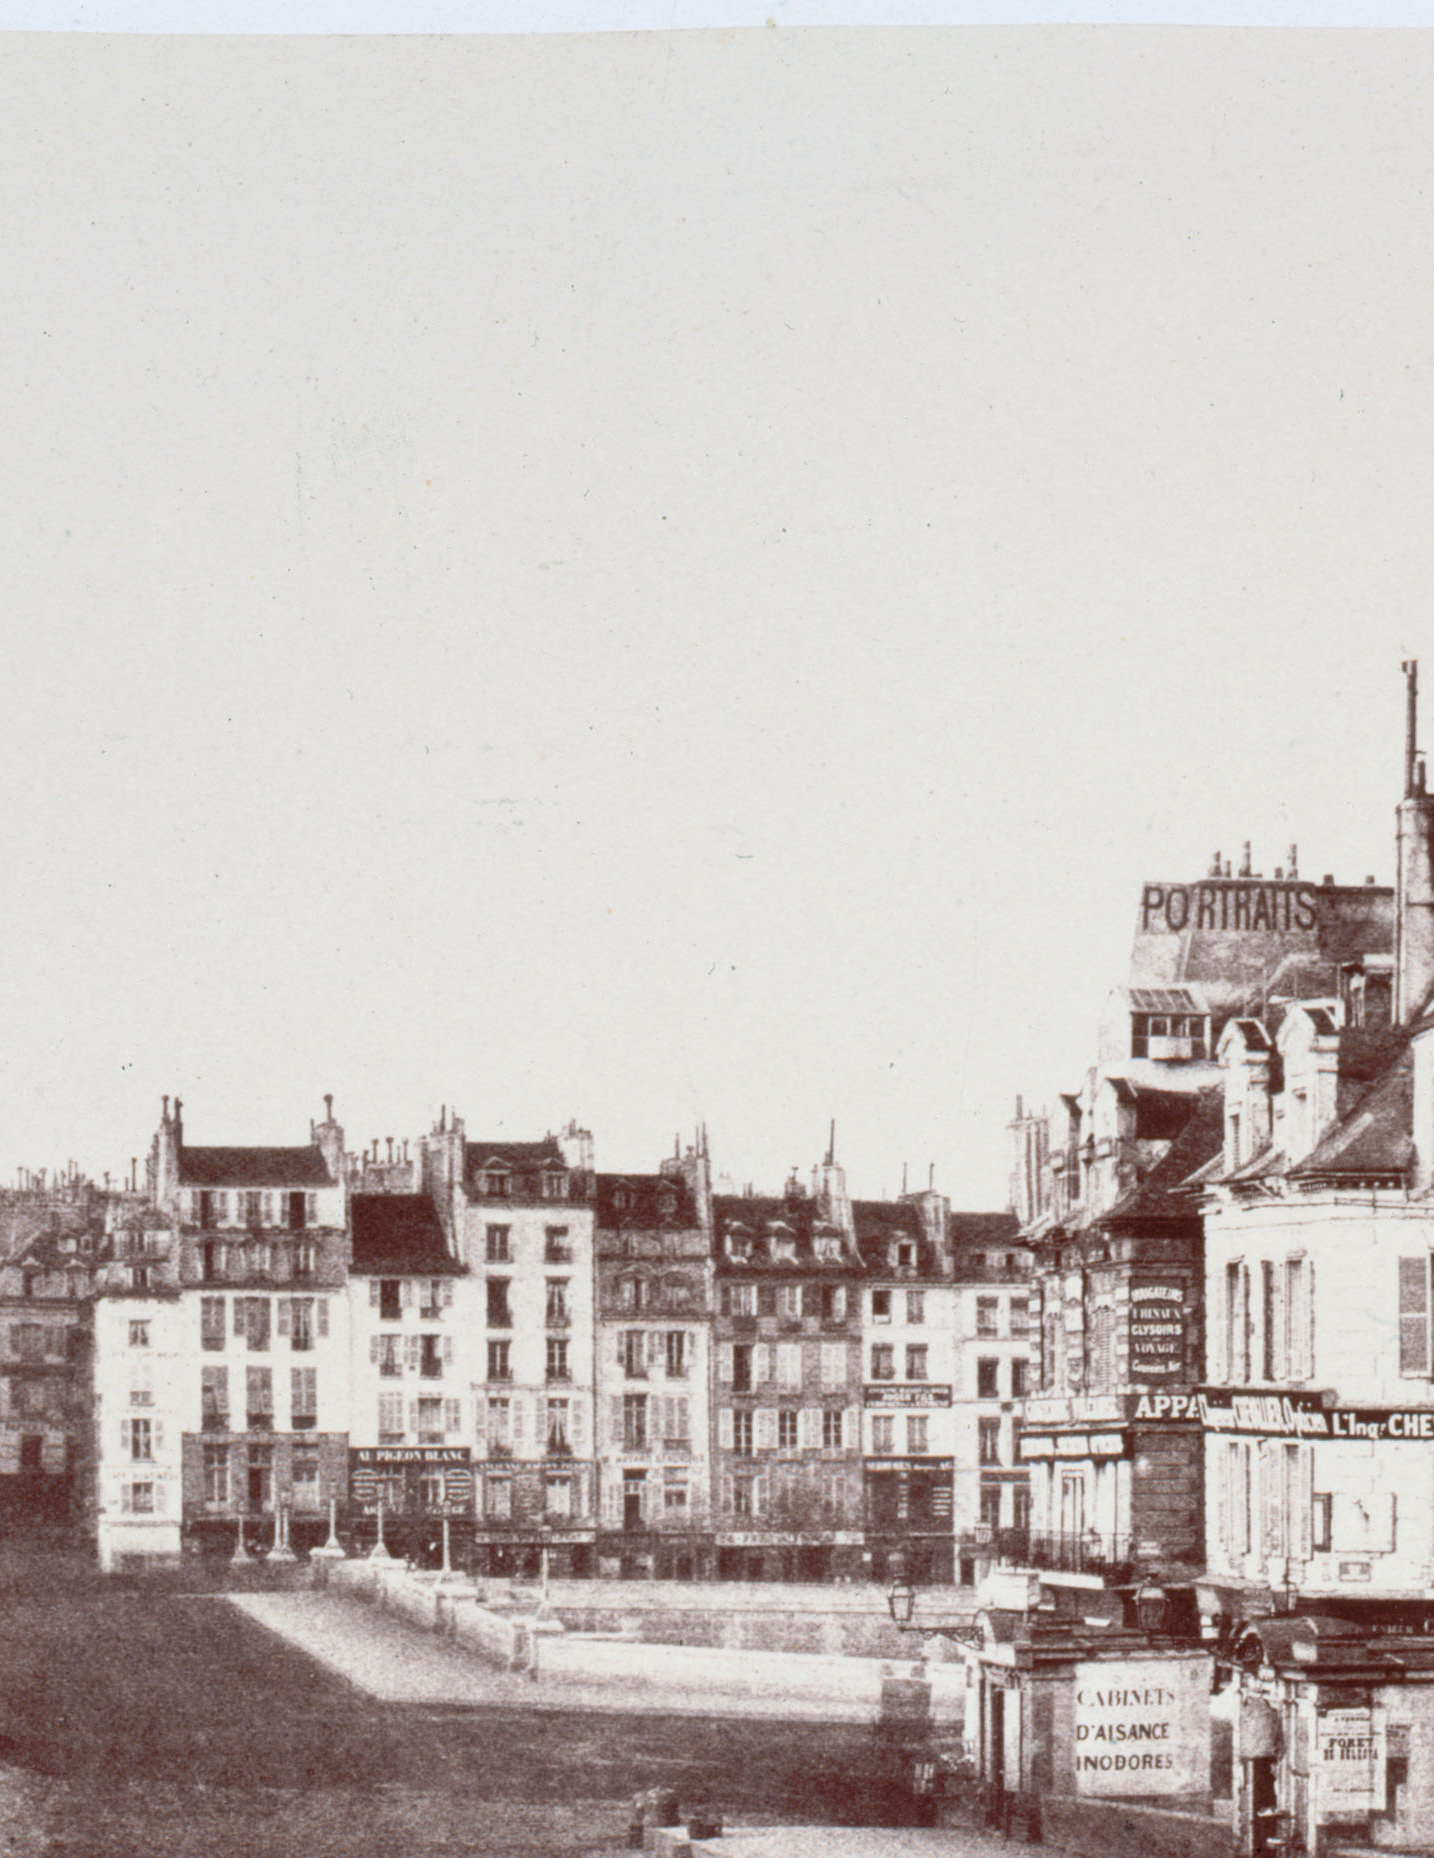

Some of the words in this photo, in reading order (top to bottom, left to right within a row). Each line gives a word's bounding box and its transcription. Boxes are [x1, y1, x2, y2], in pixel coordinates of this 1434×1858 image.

[1142, 885, 1318, 932] PORTRAITS
[1131, 1324, 1183, 1336] CLYSOIRS
[376, 1450, 423, 1462] PIGEON
[424, 1450, 466, 1462] BLANC
[1076, 1688, 1176, 1707] CABINETS
[1075, 1722, 1170, 1741] D'AISANCE
[1075, 1754, 1174, 1771] INODORES
